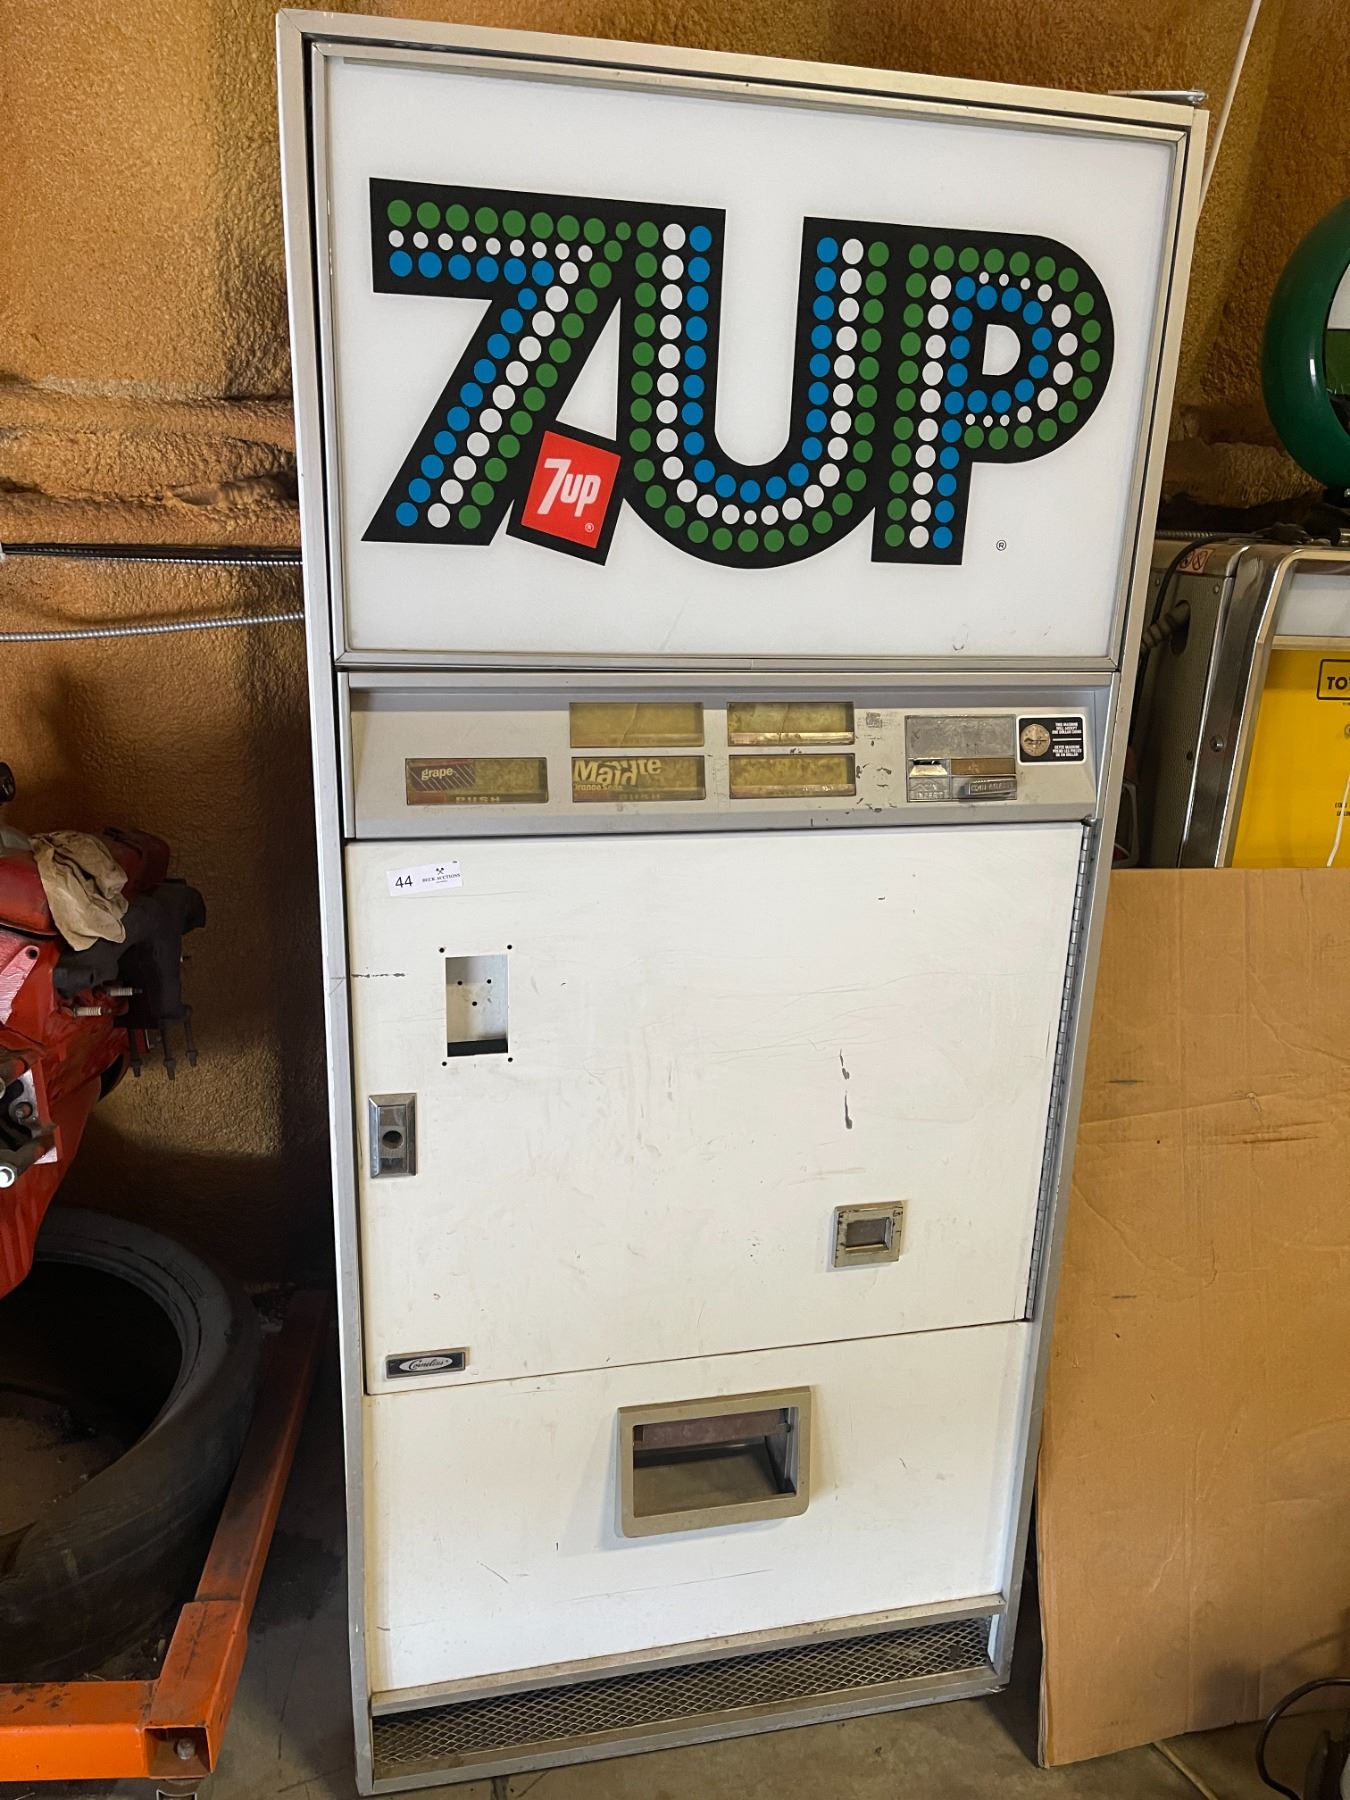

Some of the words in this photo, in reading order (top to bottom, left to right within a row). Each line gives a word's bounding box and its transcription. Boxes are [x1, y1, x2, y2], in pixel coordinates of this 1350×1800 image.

[361, 177, 1115, 569] 7UP
[537, 457, 601, 517] 7up
[1327, 676, 1350, 690] TO
[421, 767, 453, 781] grape
[395, 875, 413, 888] 44
